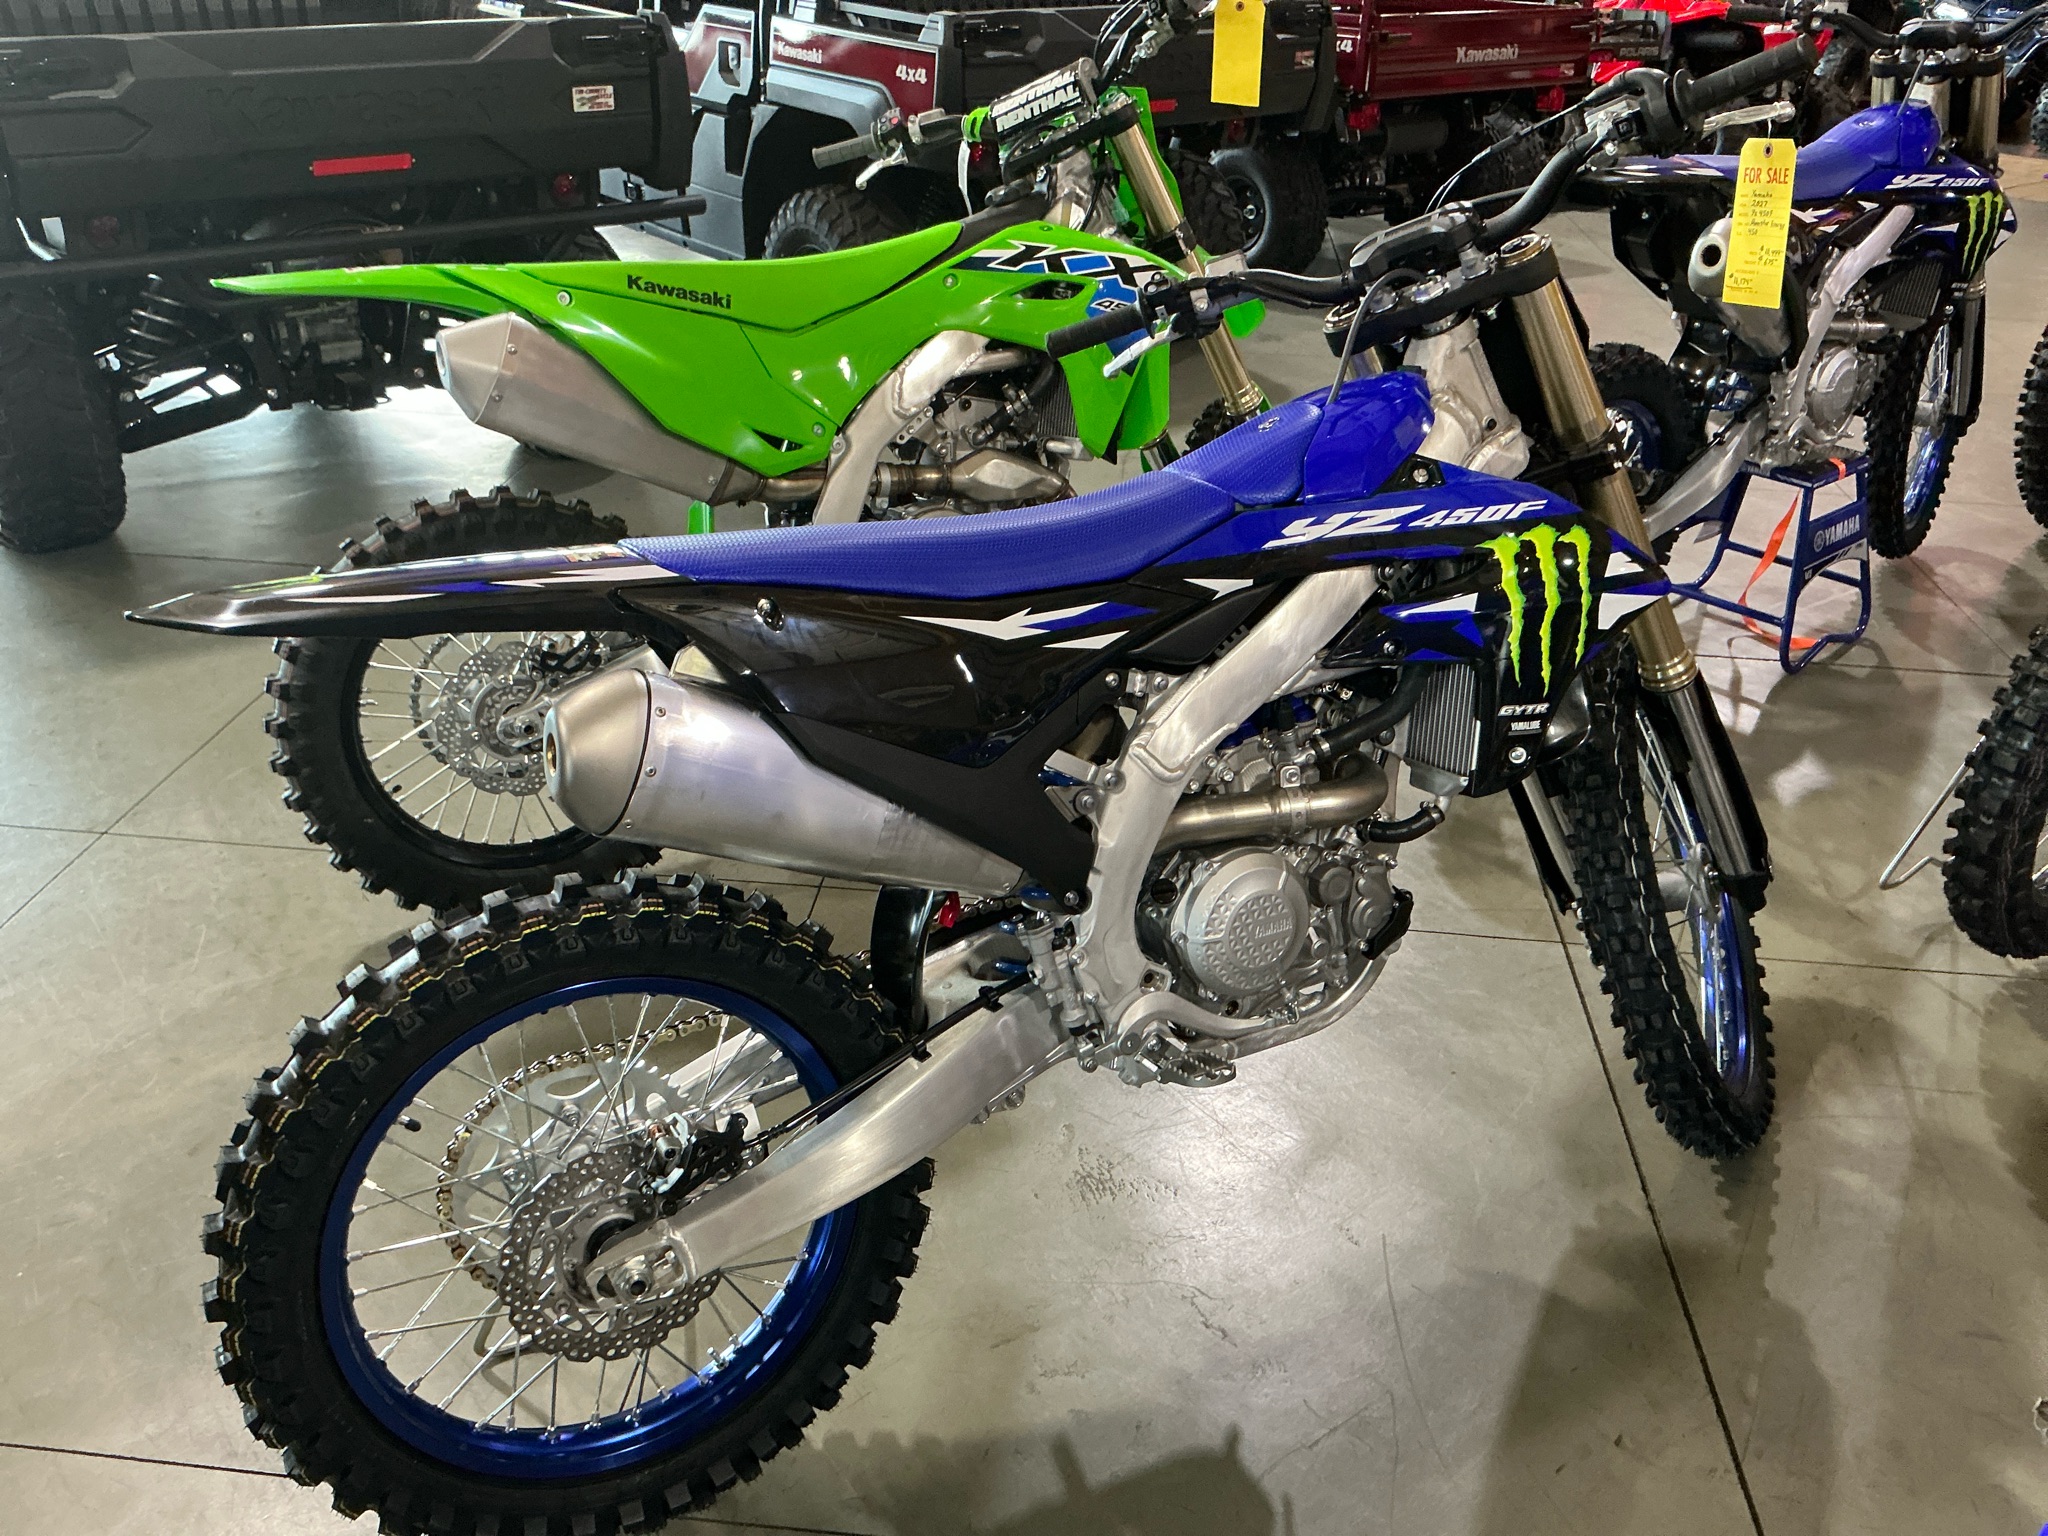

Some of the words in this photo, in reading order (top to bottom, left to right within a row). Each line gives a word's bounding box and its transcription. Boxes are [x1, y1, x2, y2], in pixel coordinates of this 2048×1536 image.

[778, 41, 822, 64] Kawasaki
[1456, 44, 1519, 64] Kawasaki
[1620, 47, 1659, 57] POLARIS
[896, 64, 927, 84] 4x4
[995, 84, 1080, 133] RENTHAL
[1743, 167, 1762, 184] FOR
[1766, 167, 1790, 185] SALE
[1884, 174, 1947, 189] YZ
[1938, 178, 1990, 187] 250F
[987, 240, 1171, 288] KX
[626, 274, 732, 310] Kawasaki
[1096, 299, 1129, 311] 45
[1262, 504, 1426, 549] YZ
[1407, 500, 1549, 528] 450F
[1825, 514, 1860, 546] YAMAHA
[1498, 702, 1550, 717] GYTR
[1254, 916, 1293, 940] YAMAHA
